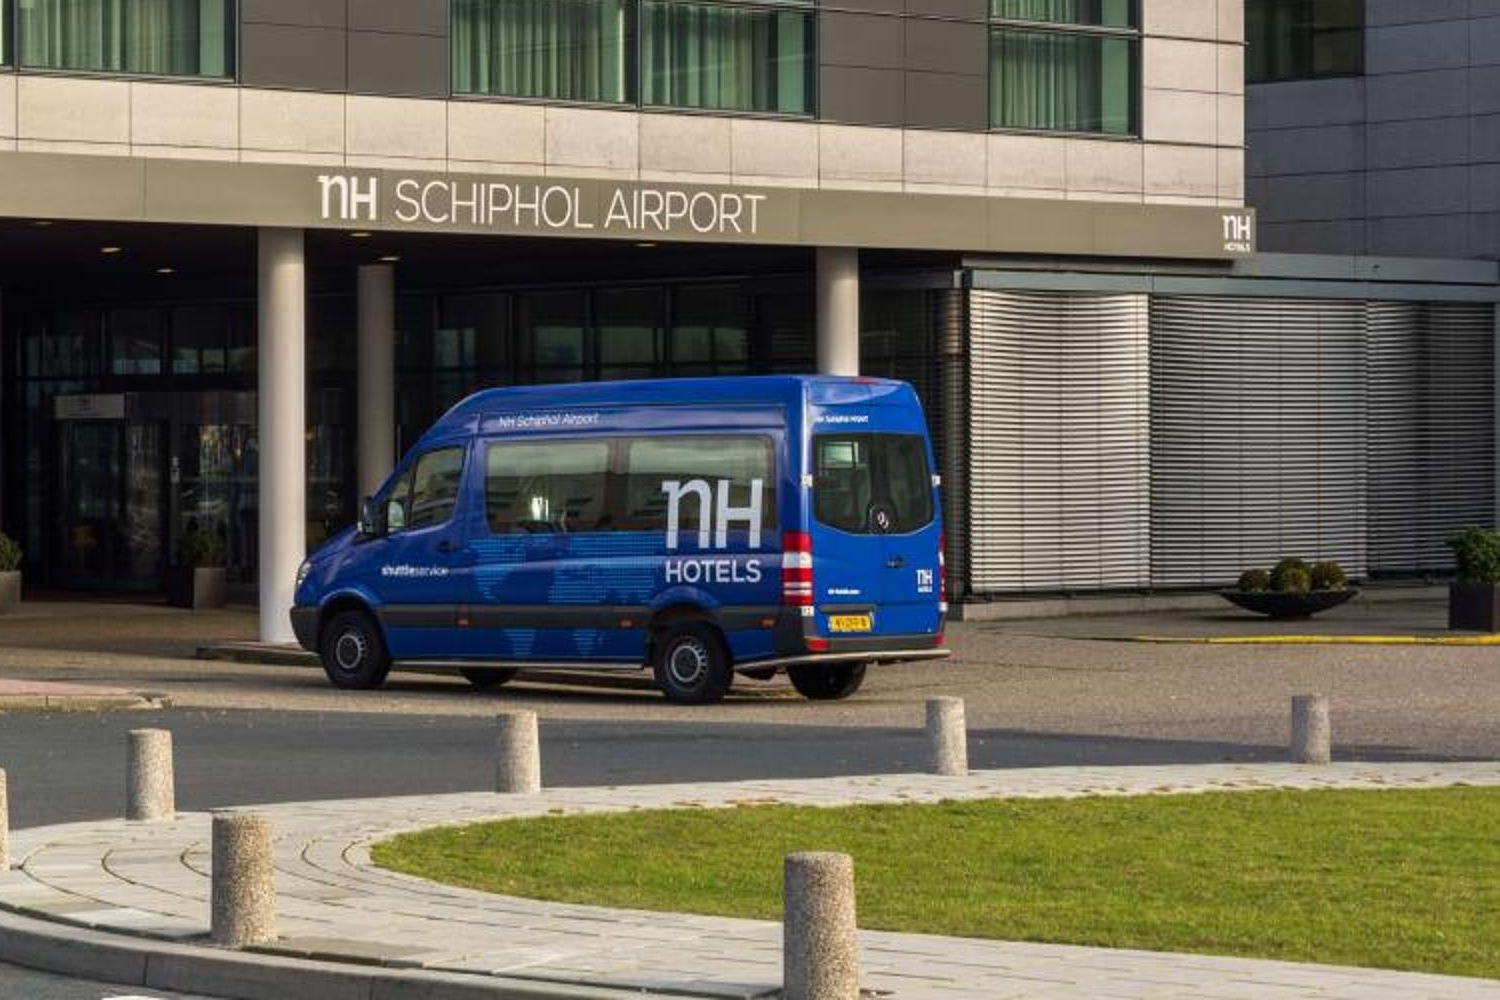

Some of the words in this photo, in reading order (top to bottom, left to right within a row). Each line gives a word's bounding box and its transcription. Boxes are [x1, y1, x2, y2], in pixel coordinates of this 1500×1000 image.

[394, 179, 594, 229] SCHIPHOL
[603, 187, 767, 234] AIRPORT
[665, 559, 762, 583] HOTELS
